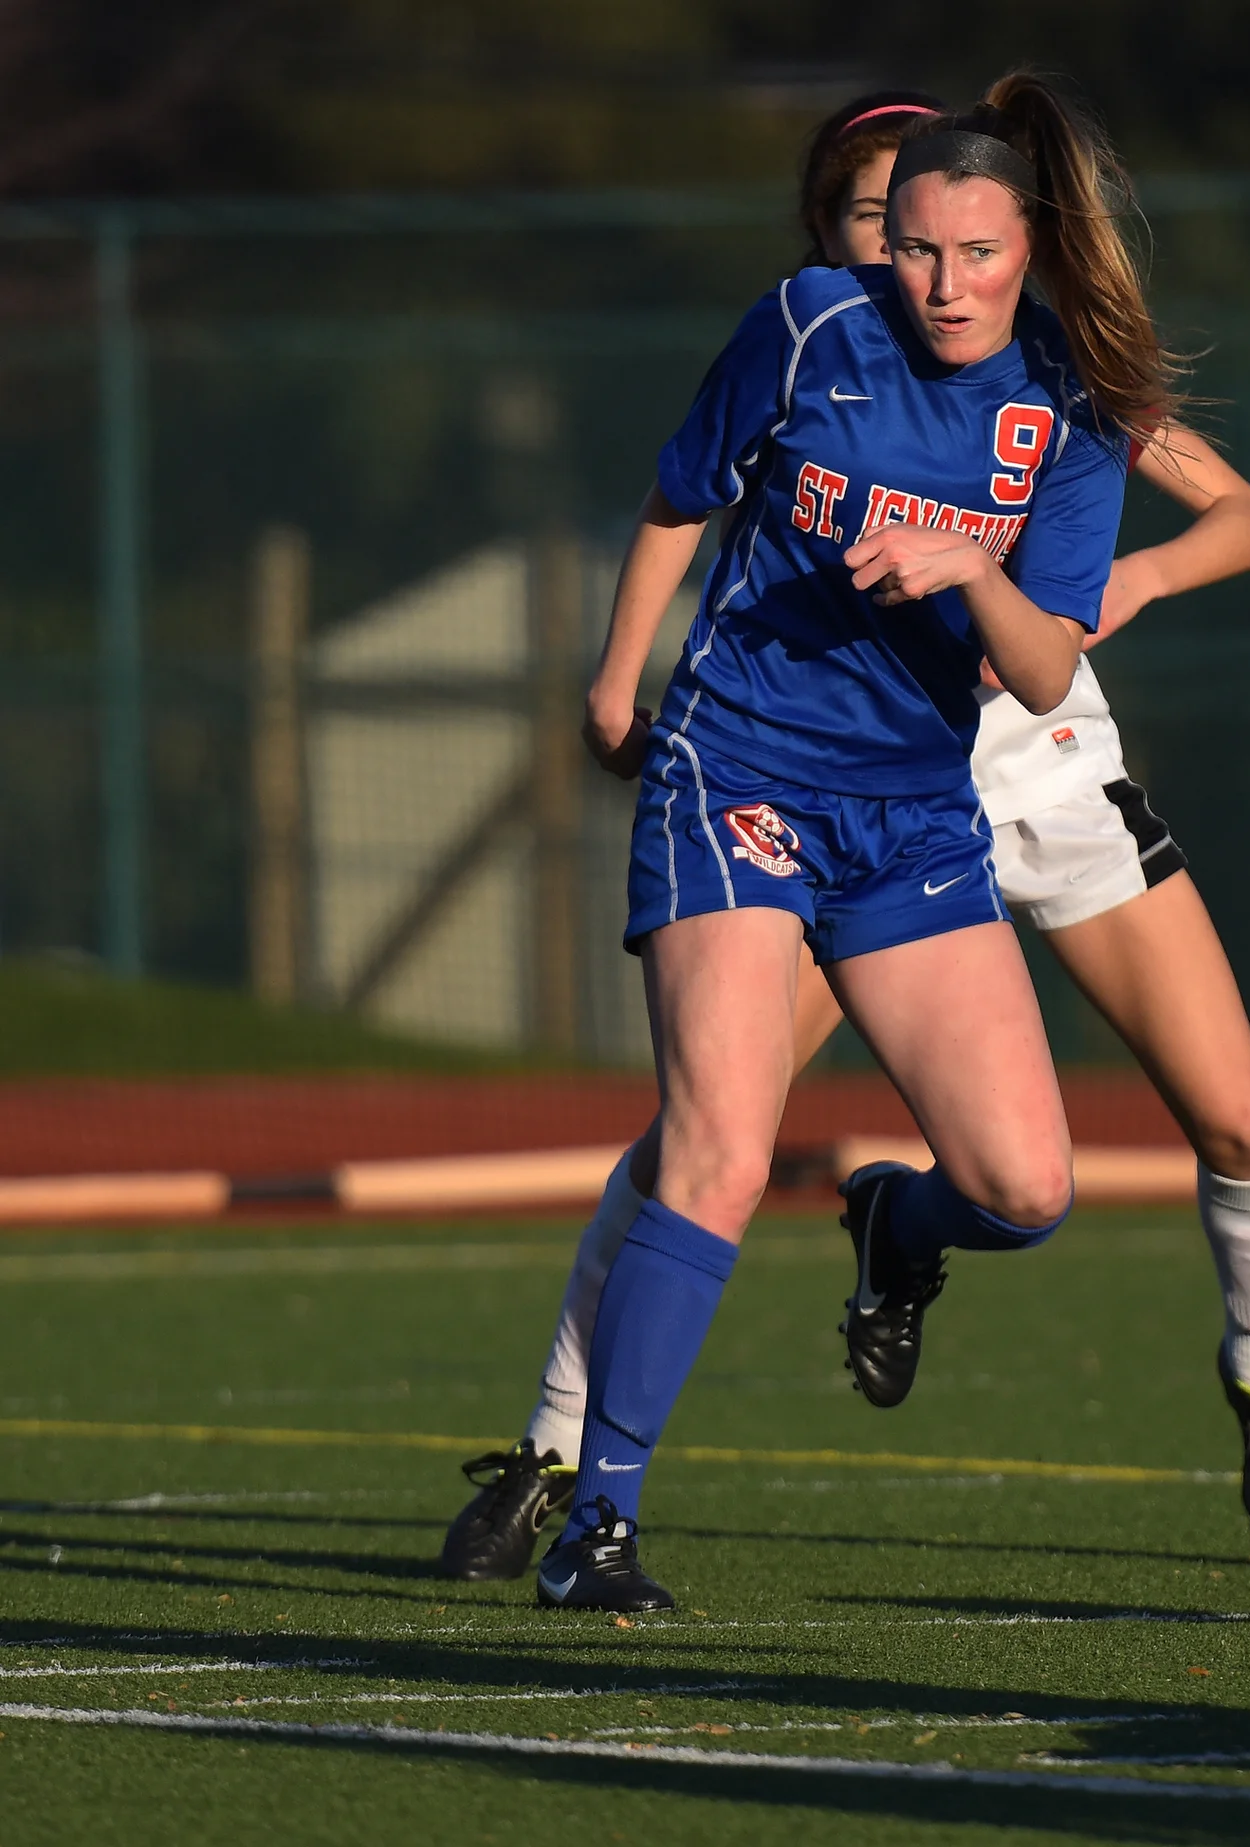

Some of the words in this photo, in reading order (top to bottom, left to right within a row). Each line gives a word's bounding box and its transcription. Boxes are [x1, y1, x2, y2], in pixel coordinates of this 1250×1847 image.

[990, 402, 1054, 504] 9
[792, 461, 848, 543] ST.
[752, 855, 793, 873] WILDCATS
